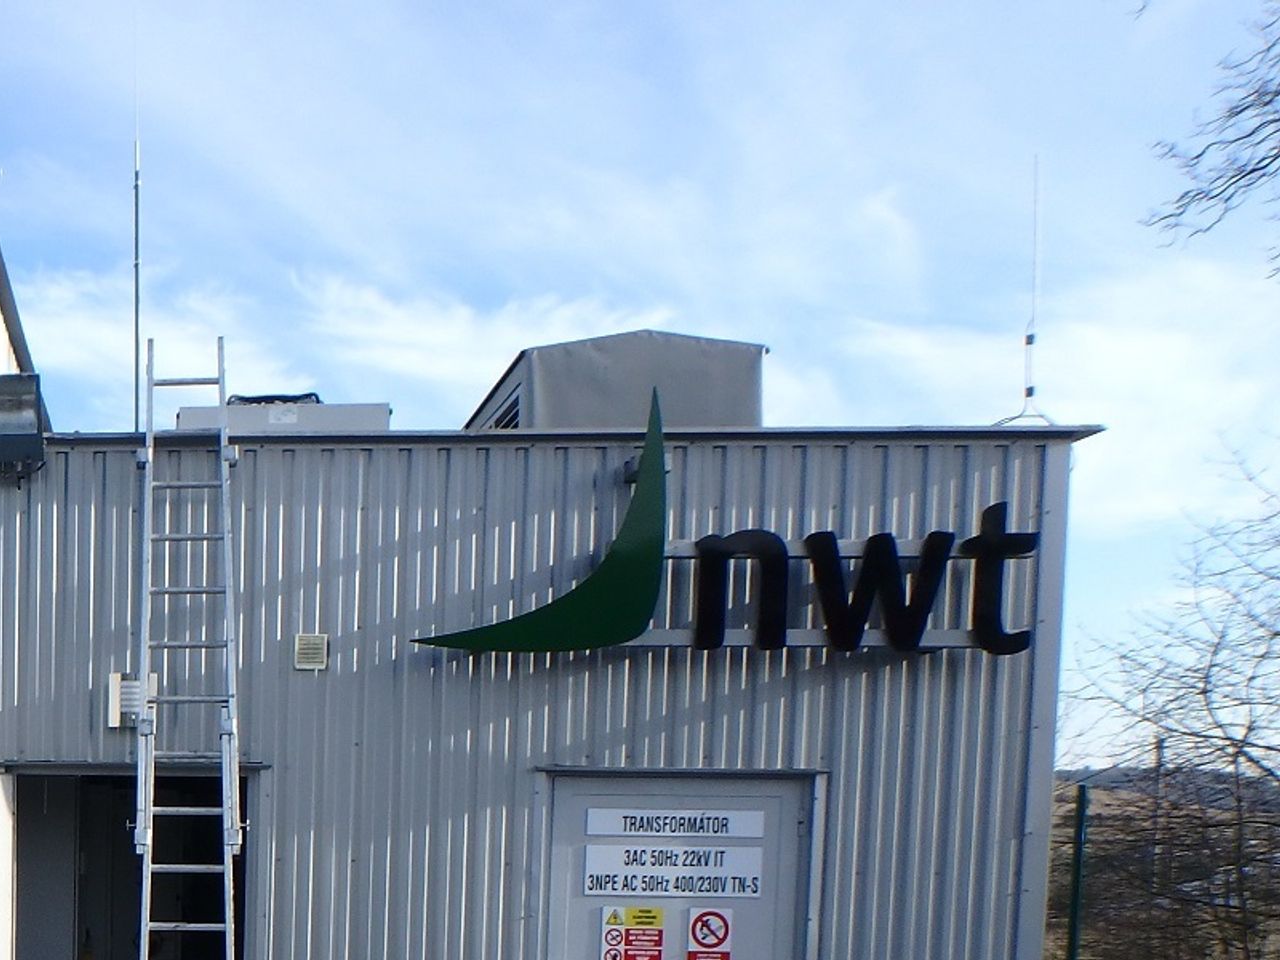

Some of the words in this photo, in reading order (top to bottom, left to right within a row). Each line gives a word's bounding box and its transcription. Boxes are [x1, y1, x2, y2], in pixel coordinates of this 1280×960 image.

[694, 501, 1040, 656] nwt
[622, 812, 729, 834] TRANSFORMÁTOR
[623, 849, 647, 866] 3AC
[650, 849, 679, 867] 50Hz
[682, 850, 712, 867] 22kV
[713, 850, 726, 867] IT
[587, 874, 619, 891] 3NPE
[621, 874, 638, 892] AC
[641, 875, 670, 892] 50Hz
[673, 875, 728, 893] 400/230V
[730, 876, 759, 894] TN-S
